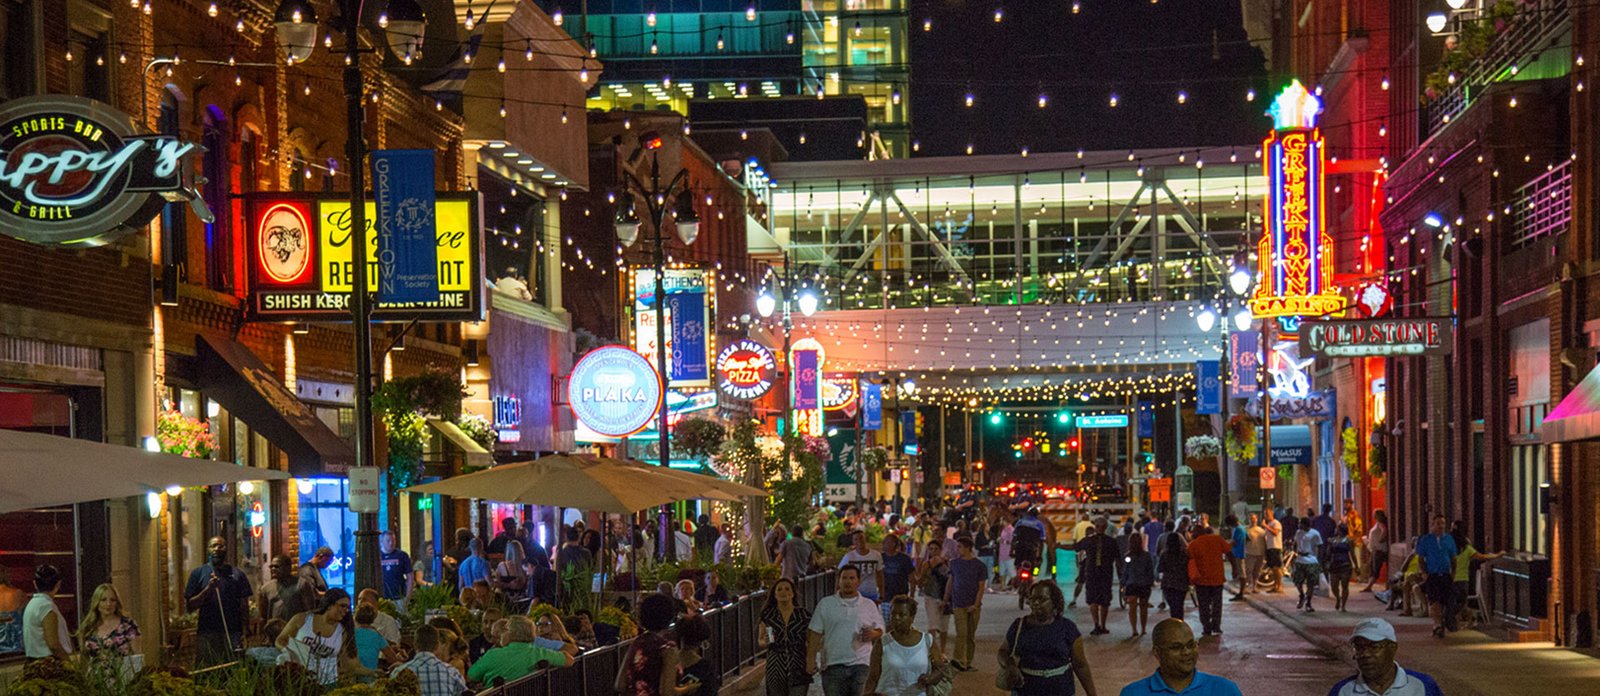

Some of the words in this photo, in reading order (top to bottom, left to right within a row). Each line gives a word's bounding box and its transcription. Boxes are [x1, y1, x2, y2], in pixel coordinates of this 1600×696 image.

[12, 116, 65, 138] SPORTS
[74, 120, 104, 142] BAR
[29, 205, 73, 219] GRILL
[1281, 133, 1311, 296] GREEKTOWN
[374, 158, 396, 294] GREEKTOWN
[397, 273, 436, 281] Preservation
[404, 280, 431, 289] Society
[265, 295, 310, 309] SHISH
[1253, 299, 1341, 315] CASINO
[1308, 323, 1365, 351] COLD
[1368, 321, 1440, 348] STONE
[1330, 344, 1418, 355] CREAMERY
[716, 344, 739, 370] PIZZA
[728, 370, 761, 383] PIZZA
[581, 387, 647, 402] PLAKA
[720, 379, 771, 398] TAVERNA
[1271, 448, 1302, 457] PEGASUS
[351, 488, 377, 496] STOPPING
